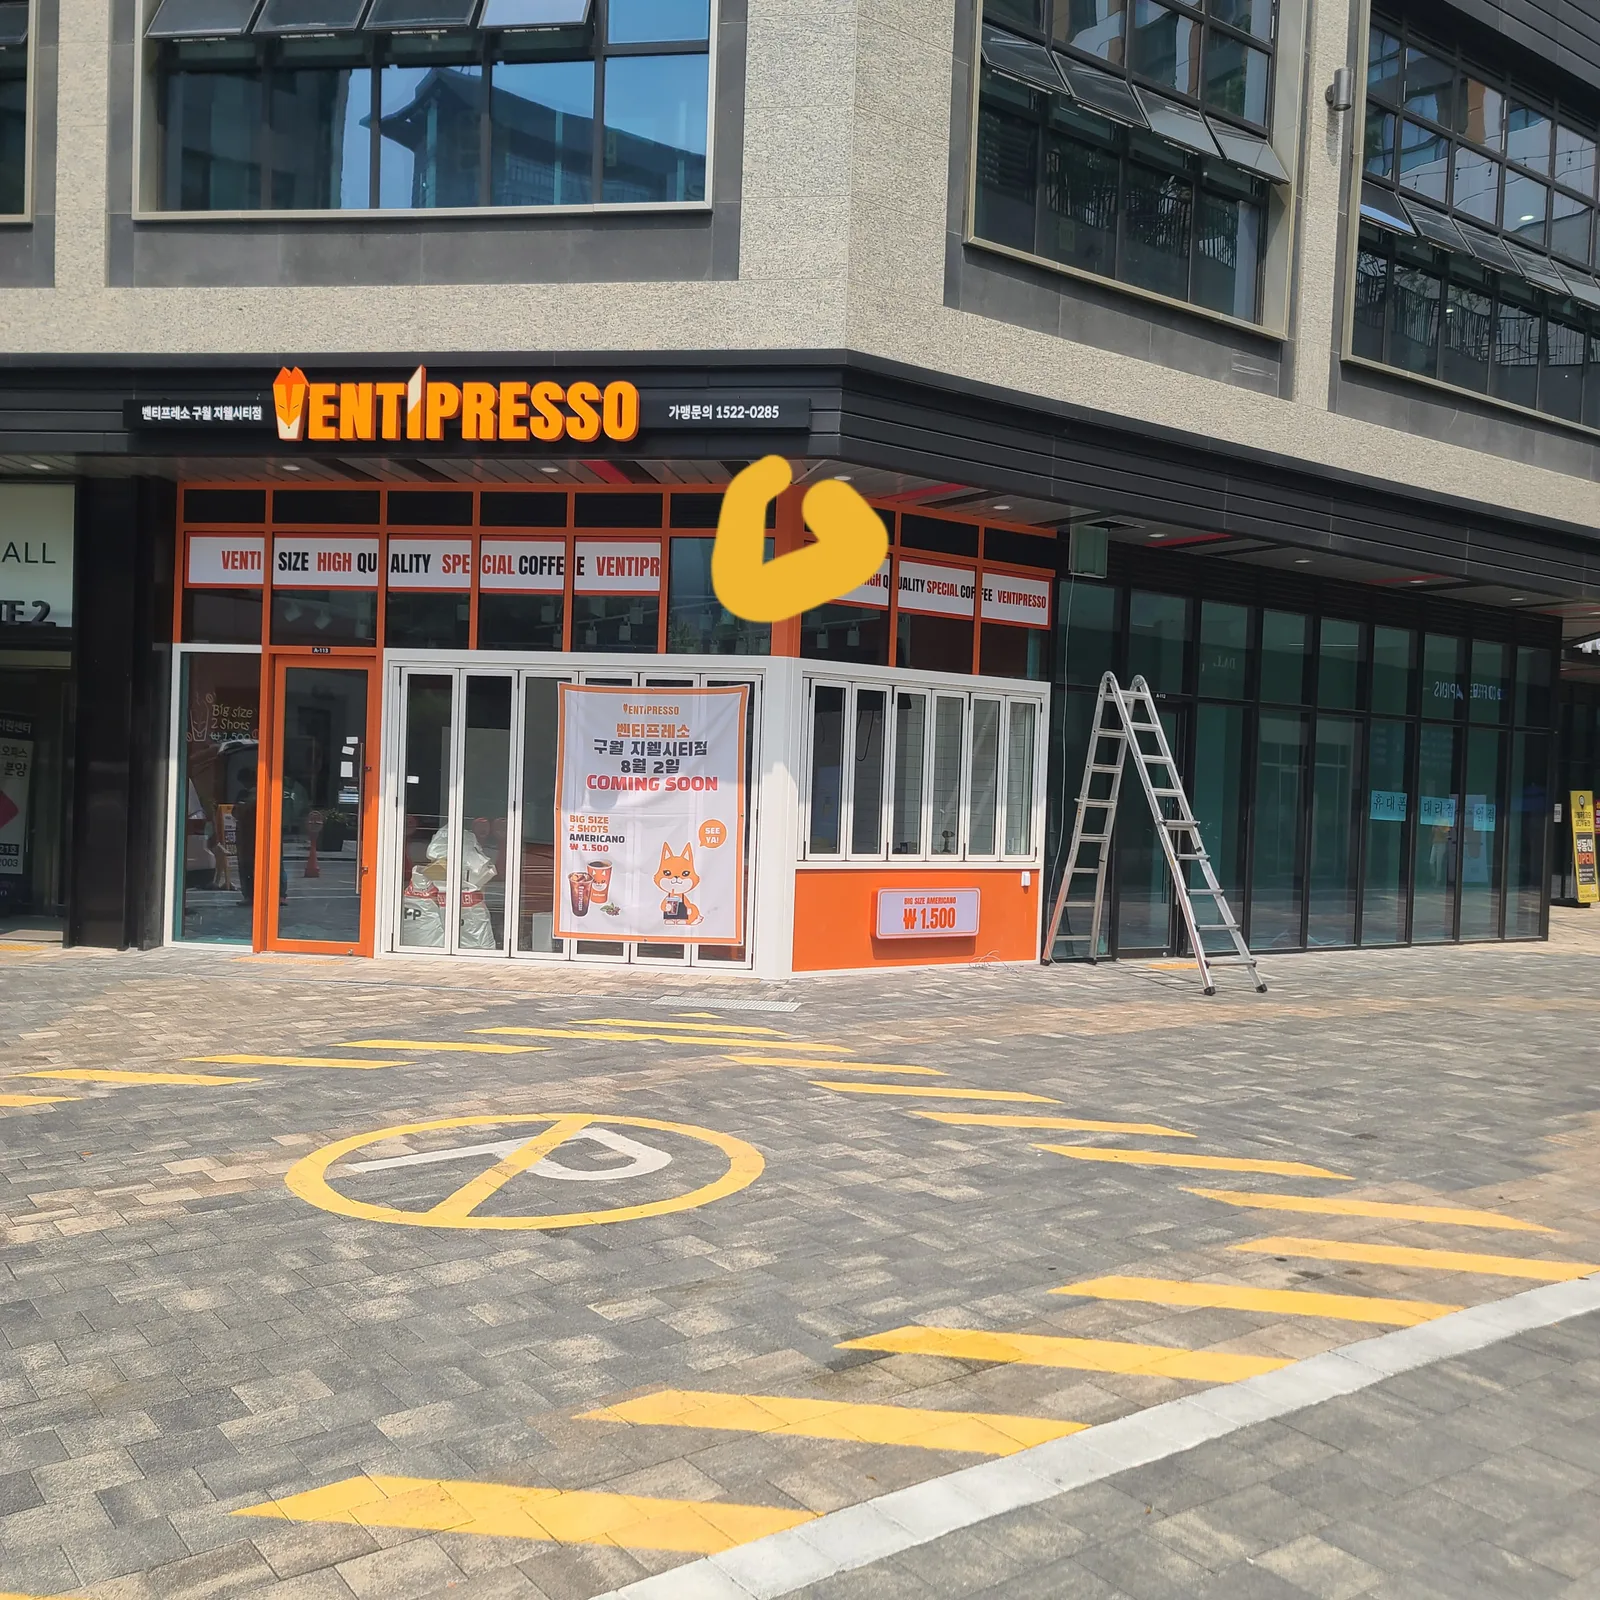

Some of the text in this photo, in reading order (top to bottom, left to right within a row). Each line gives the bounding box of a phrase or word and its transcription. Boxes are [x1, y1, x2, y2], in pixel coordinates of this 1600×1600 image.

[272, 364, 640, 441] VENTIPRESSO
[141, 404, 262, 421] 벤티프레소 구월 지웰시티점
[668, 404, 779, 420] 가맹문의 1522-0285
[221, 550, 261, 570] VENTI
[278, 551, 309, 571] SIZE
[317, 552, 352, 572] HIGH
[926, 580, 959, 598] SPECIAL
[997, 590, 1047, 609] VENTIPRESSO
[212, 704, 253, 718] Big size
[622, 703, 680, 715] VENTIPRESSO
[211, 718, 251, 730] 2 Shots
[616, 723, 690, 738] 벤티프레소
[593, 738, 708, 757] 구월 지웰시티점
[620, 758, 680, 774] 8월 2일
[586, 774, 718, 792] COMING SOON
[569, 815, 609, 824] BIG SIZE
[577, 825, 609, 834] SHOTS
[569, 833, 625, 844] AMERICANO
[706, 836, 719, 844] YA!
[582, 843, 609, 852] 1.500
[904, 896, 957, 905] BIG SIZE AMERICANO
[903, 907, 956, 930] ₩ 1.500
